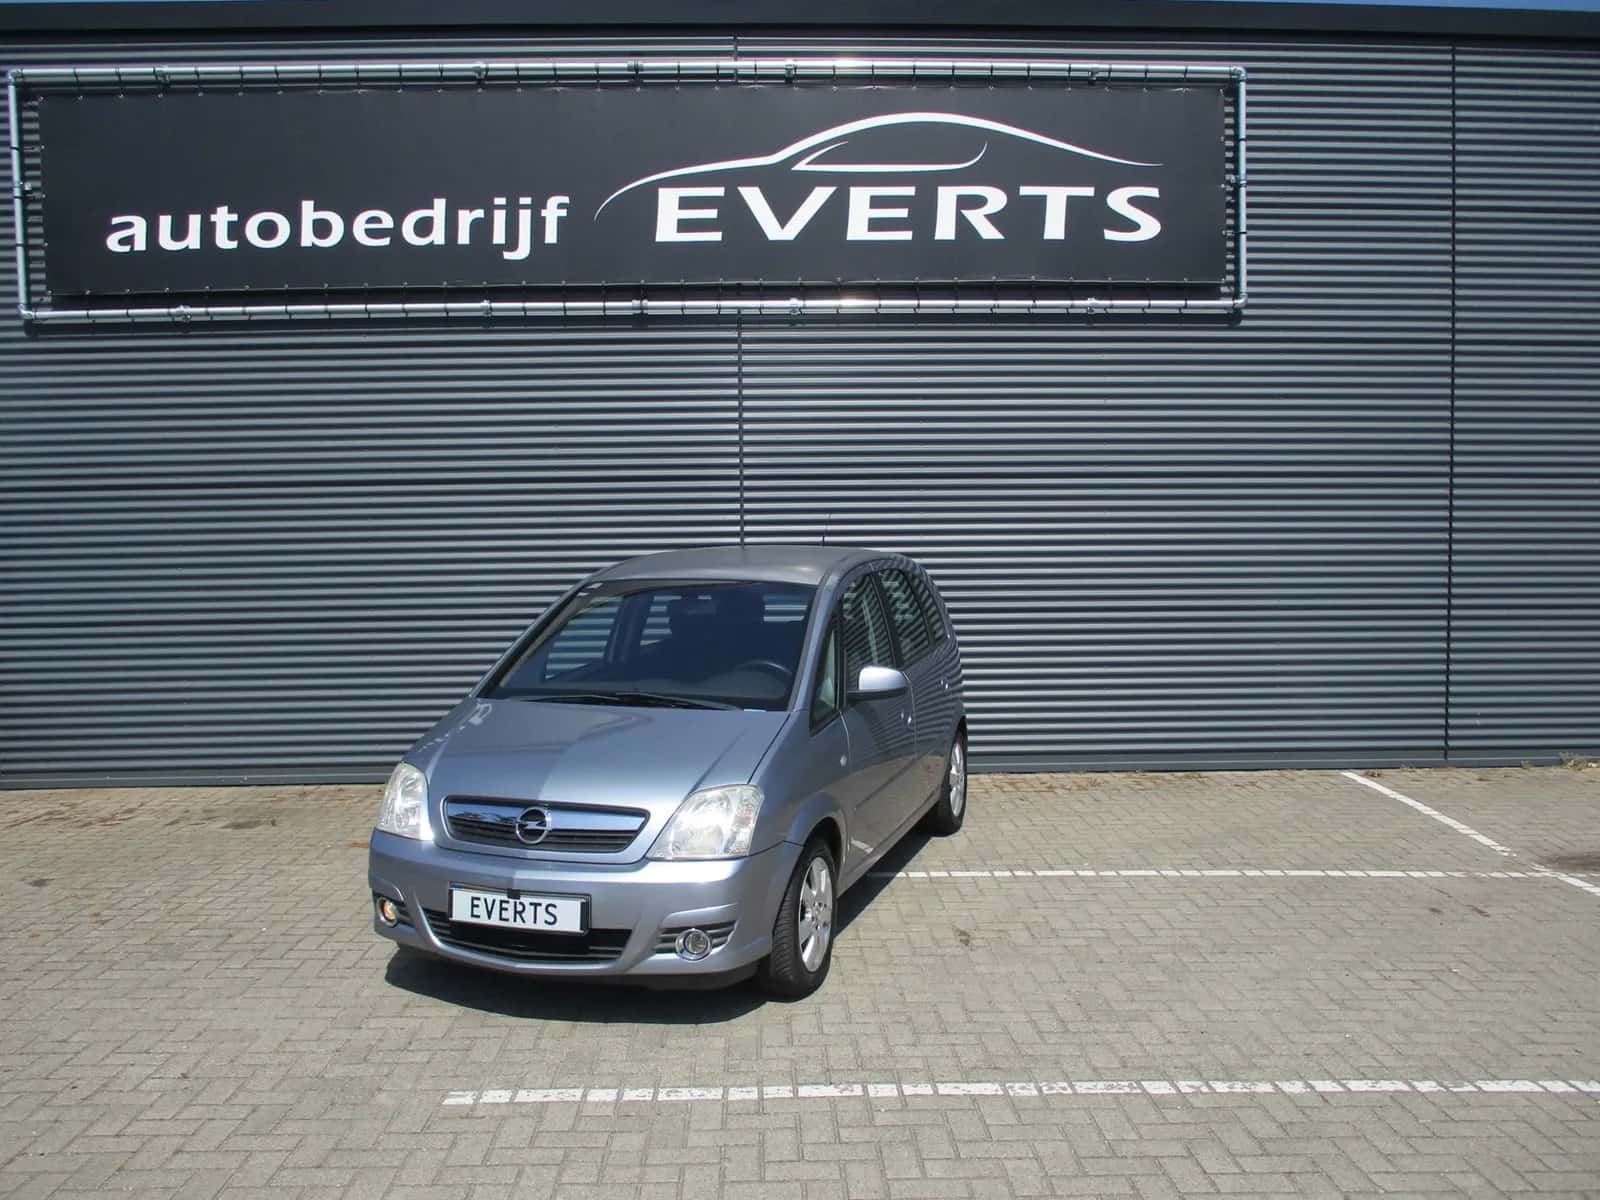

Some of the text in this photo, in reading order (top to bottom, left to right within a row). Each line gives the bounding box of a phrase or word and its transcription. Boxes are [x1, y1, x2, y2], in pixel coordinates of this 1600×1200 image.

[106, 186, 1162, 260] autobedrijf EVERTS
[470, 896, 558, 926] EVERTS
